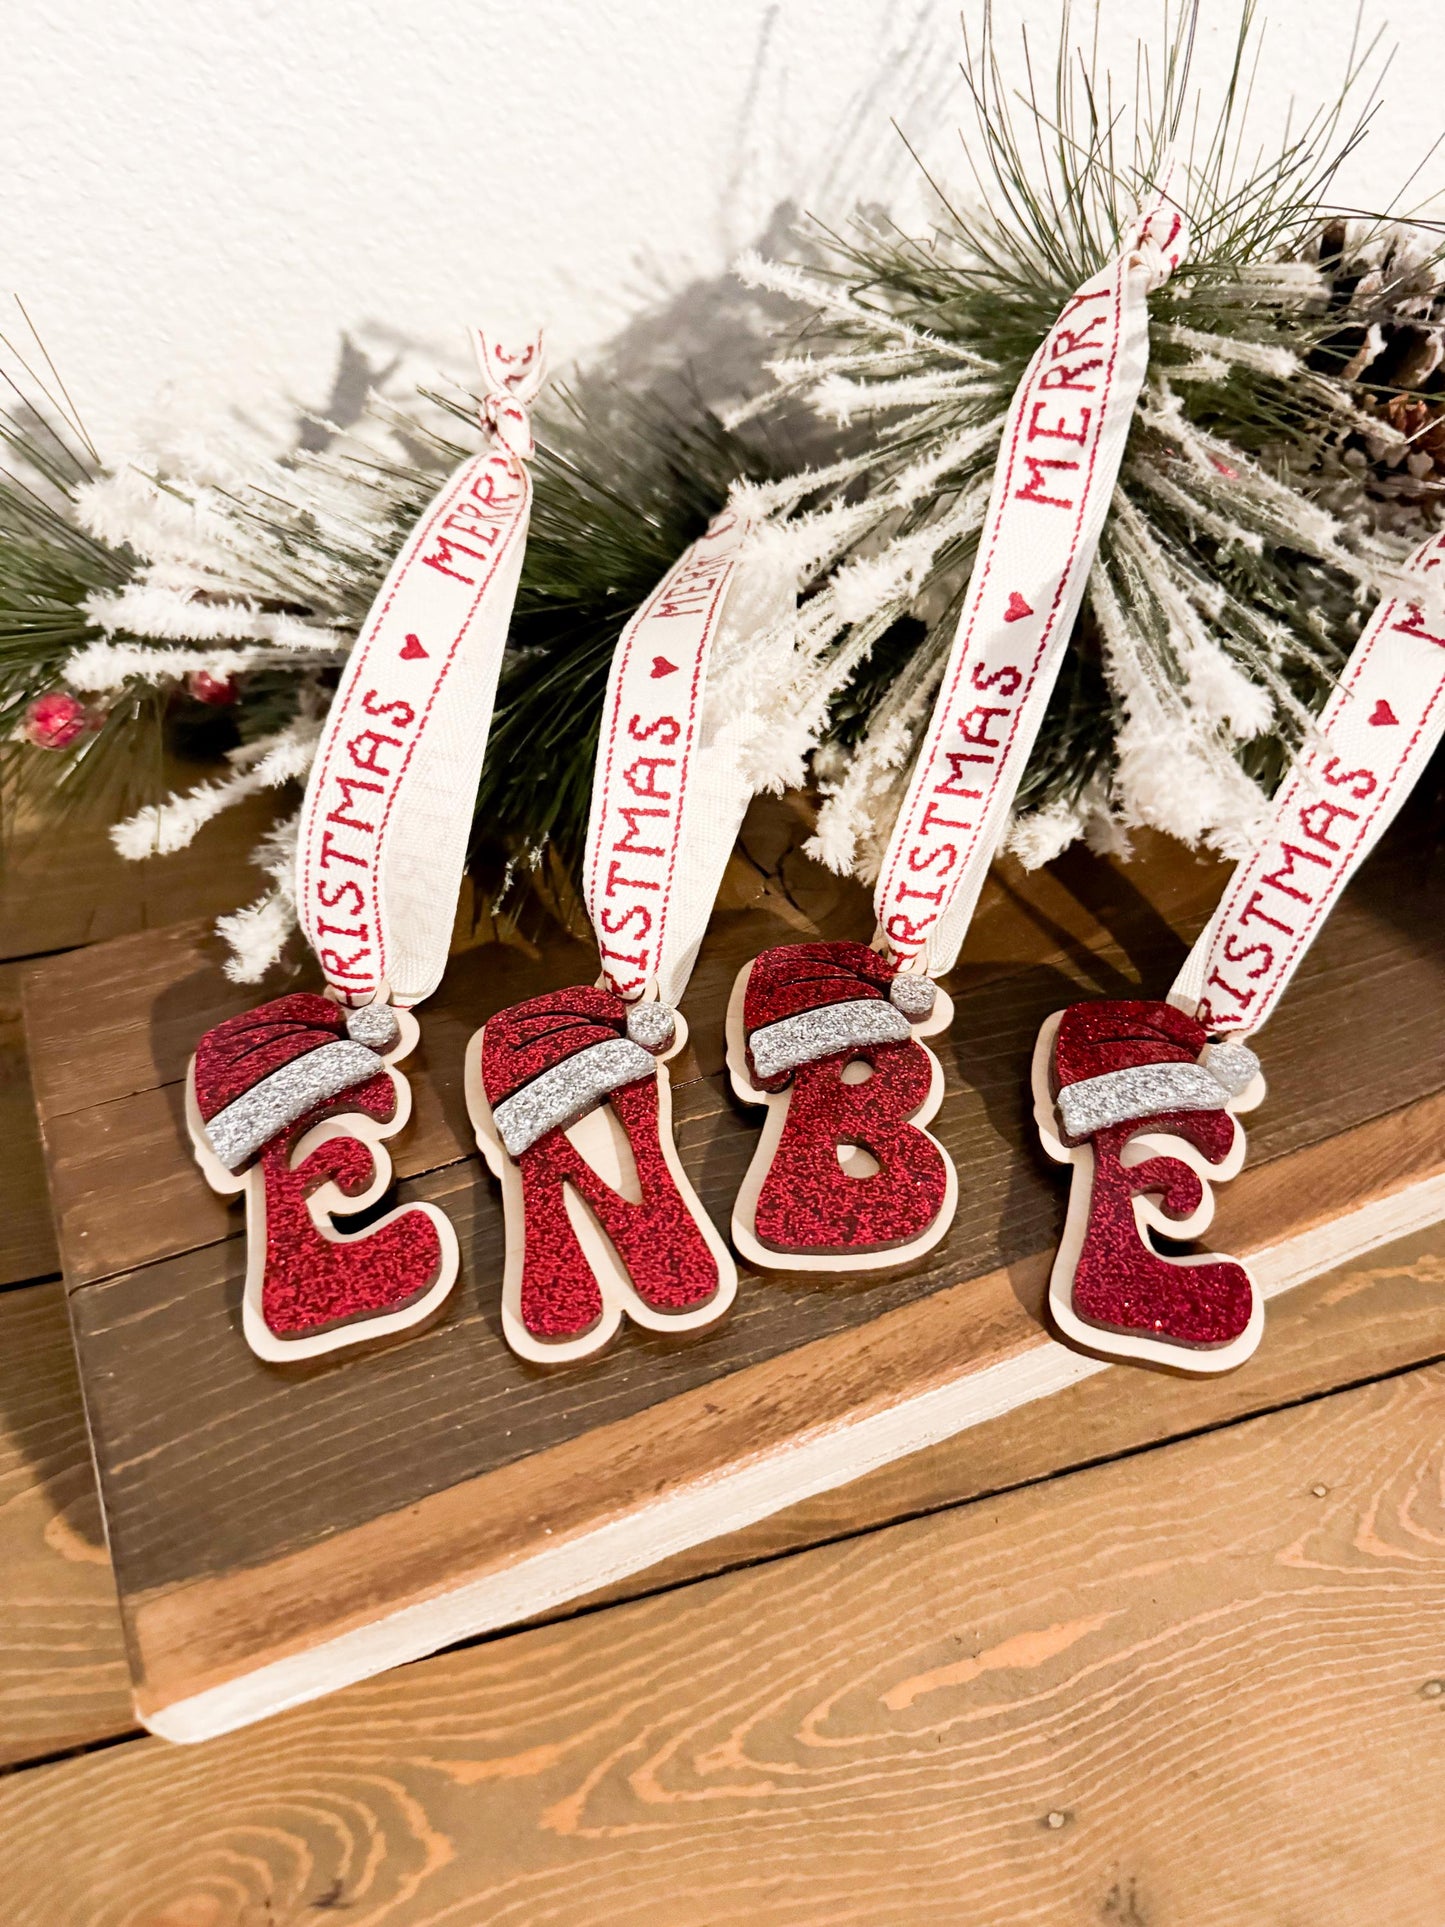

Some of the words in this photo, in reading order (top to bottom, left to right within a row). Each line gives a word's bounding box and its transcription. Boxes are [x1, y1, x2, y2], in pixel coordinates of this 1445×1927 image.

[885, 661, 1022, 969] RISTMAS
[1015, 289, 1111, 510] MERRY
[600, 713, 681, 996] RISTMAS
[1196, 756, 1378, 1030] RISTMAS
